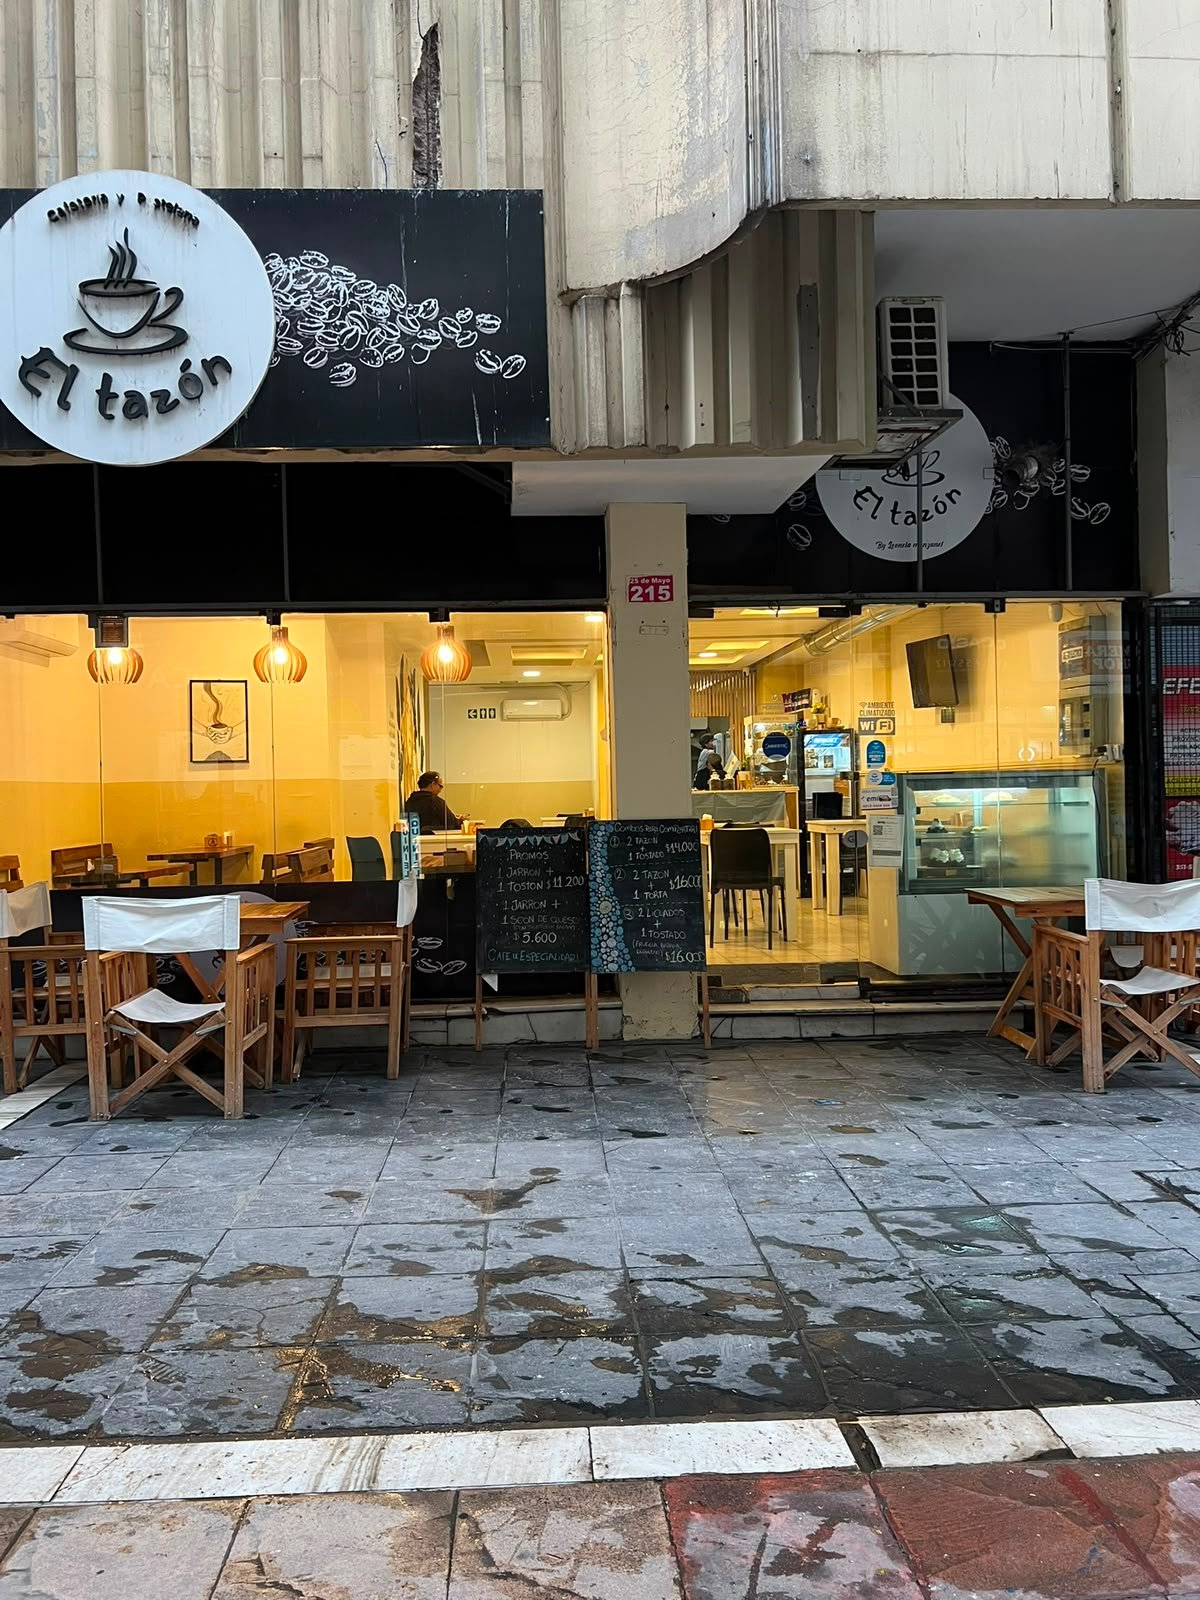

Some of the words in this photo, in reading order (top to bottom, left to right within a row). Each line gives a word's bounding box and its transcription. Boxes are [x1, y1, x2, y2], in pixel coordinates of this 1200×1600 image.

[18, 346, 80, 412] El
[95, 354, 233, 420] tazón
[853, 485, 884, 520] El
[890, 488, 962, 526] tazón
[651, 577, 671, 585] Mayo
[630, 585, 671, 601] 215
[867, 701, 895, 709] AMBIENTE
[859, 709, 896, 717] CLIMATIZADO
[627, 836, 633, 847] 2
[635, 837, 658, 845] TAZON
[509, 849, 549, 860] PROMOS
[628, 852, 633, 861] 1
[635, 851, 665, 860] TOSTADO
[497, 867, 504, 878] 1
[506, 866, 540, 878] JARRON
[633, 869, 640, 880] 2
[641, 869, 670, 880] TAZON
[496, 882, 504, 893] 1
[507, 880, 543, 892] TOSTON
[633, 890, 640, 900] 1
[644, 890, 668, 900] TORTA
[511, 899, 547, 911] JARRON
[638, 907, 645, 918] 2
[501, 914, 509, 925] 1
[641, 927, 648, 938] 1
[648, 929, 687, 940] TOSTADO
